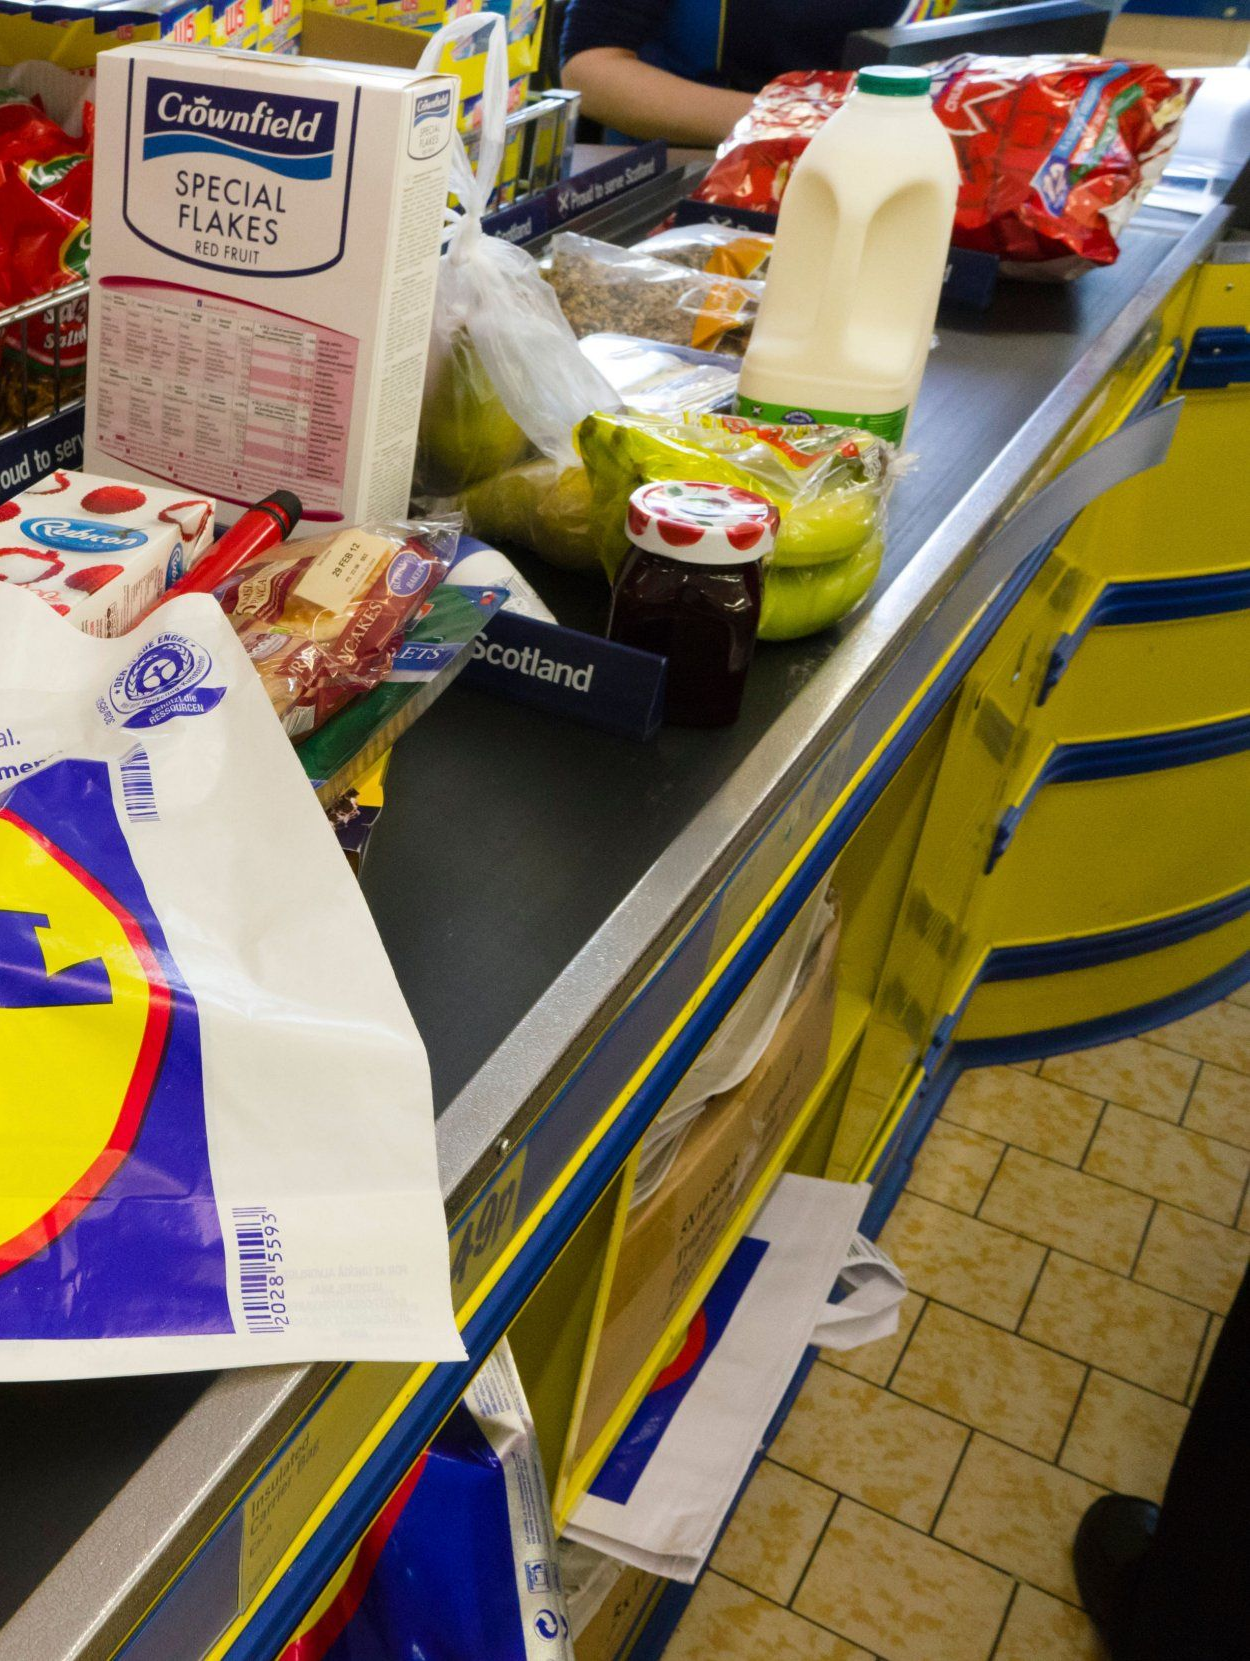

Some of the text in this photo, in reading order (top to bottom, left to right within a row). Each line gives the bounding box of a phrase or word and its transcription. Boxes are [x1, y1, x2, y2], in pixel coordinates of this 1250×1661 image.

[157, 91, 323, 143] Crownfield
[175, 170, 286, 214] SPECIAL
[178, 204, 278, 246] FLAKES
[196, 240, 260, 265] RED FRUIT
[34, 448, 50, 472] to
[55, 436, 85, 463] serv
[30, 520, 138, 546] Rubicon
[332, 543, 361, 577] 29 FEB 12
[114, 670, 127, 689] DER
[158, 634, 189, 646] ENGEL
[472, 632, 594, 692] Scotland
[149, 703, 204, 725] RESSOURCEN
[450, 1179, 516, 1283] 49p
[261, 1213, 290, 1326] 2028 5593
[251, 1432, 310, 1516] Insulated
